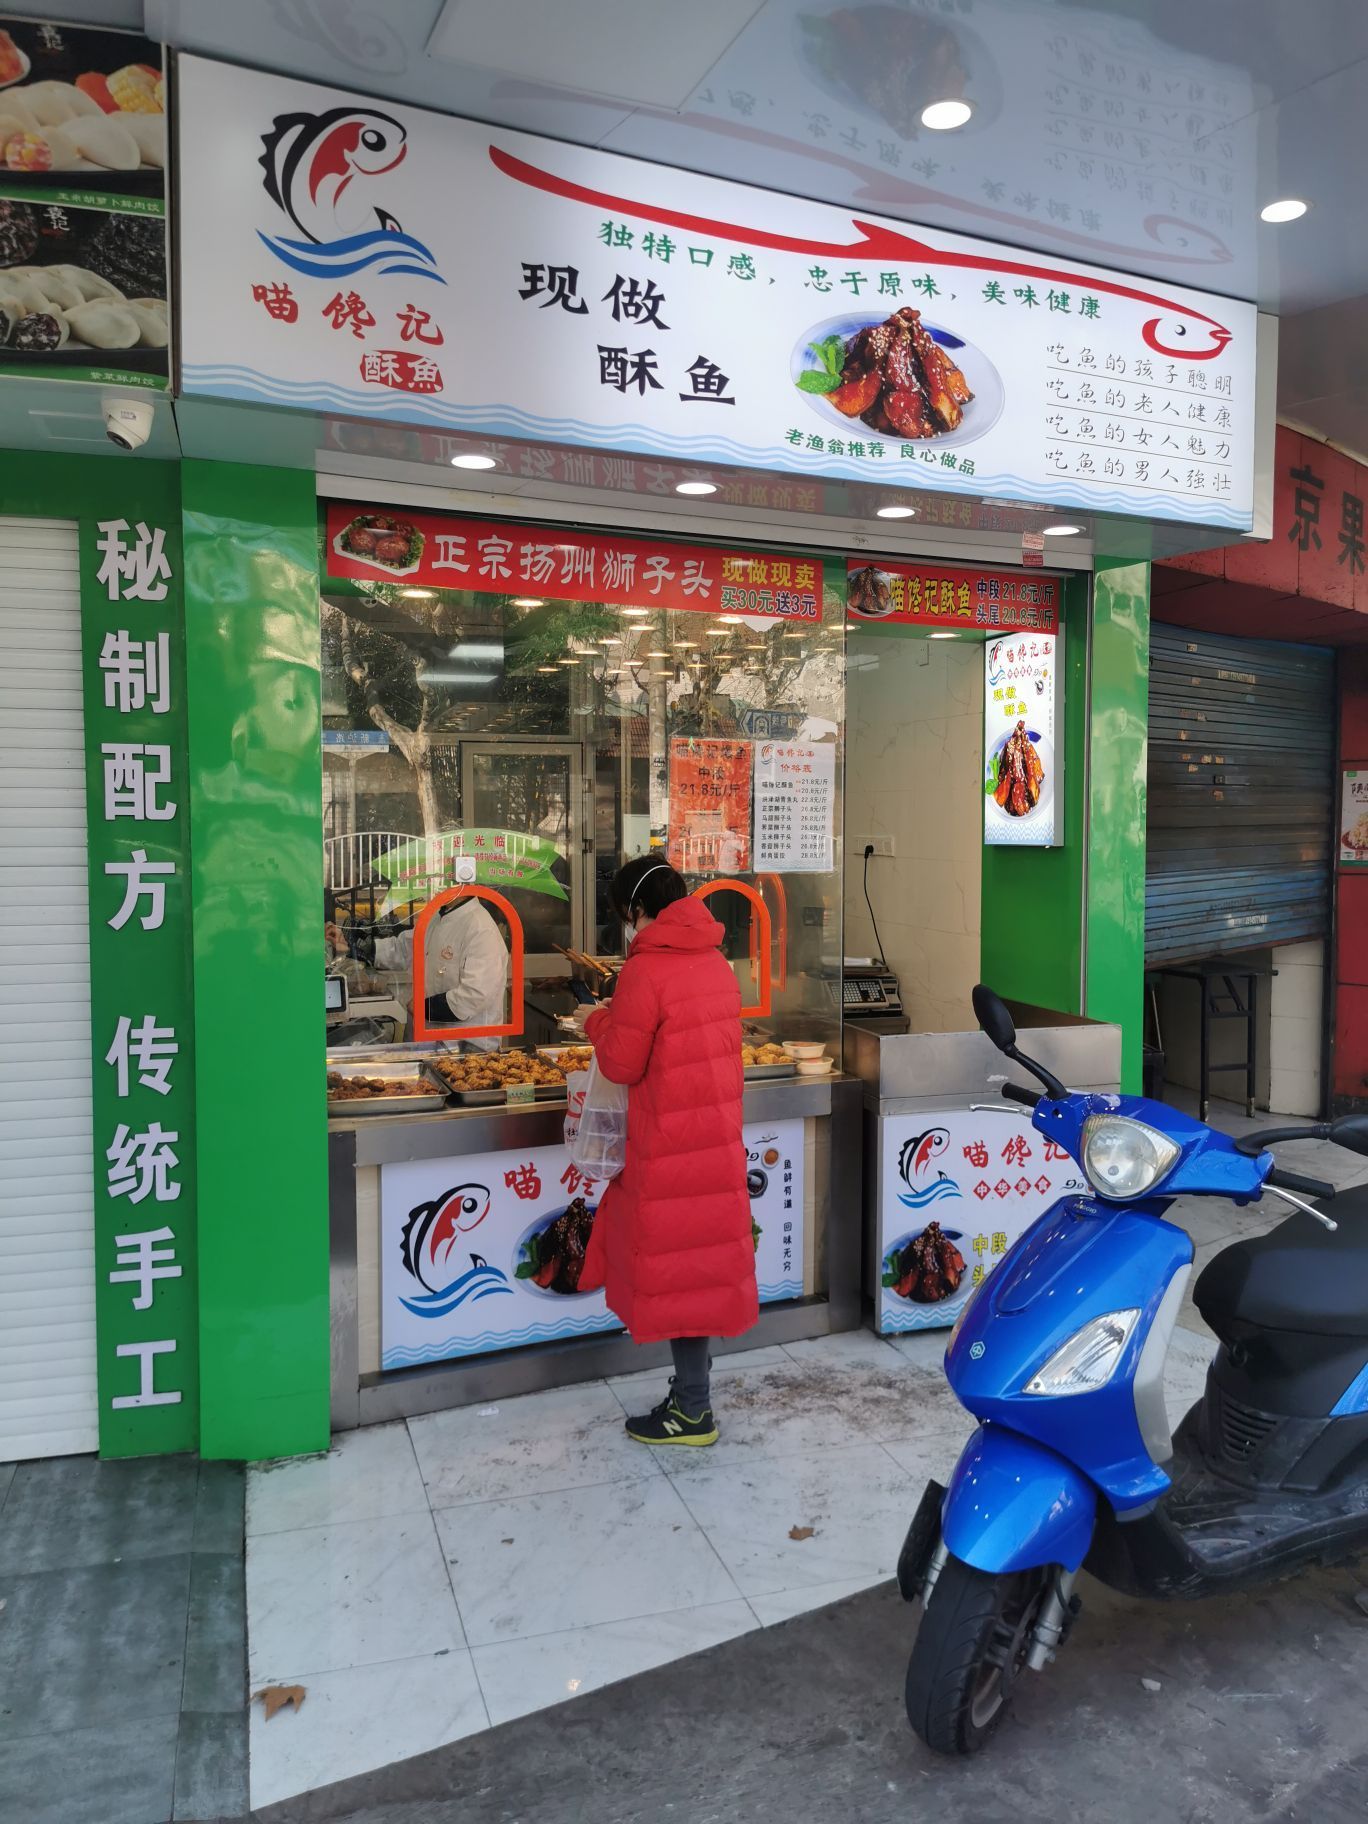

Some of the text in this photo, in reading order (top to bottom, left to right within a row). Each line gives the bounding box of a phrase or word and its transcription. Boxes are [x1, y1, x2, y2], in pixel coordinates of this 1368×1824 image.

[251, 281, 445, 346] 喵馋记
[518, 261, 671, 330] 现做
[597, 344, 736, 406] 酥鱼
[784, 428, 977, 477] 老渔翁推荐 良心做品
[431, 533, 713, 598] 正宗扬州狮子头
[721, 556, 817, 591] 现做现卖
[720, 585, 818, 618] 买30元送3元
[96, 519, 183, 1410] 秘制配方 传统手工
